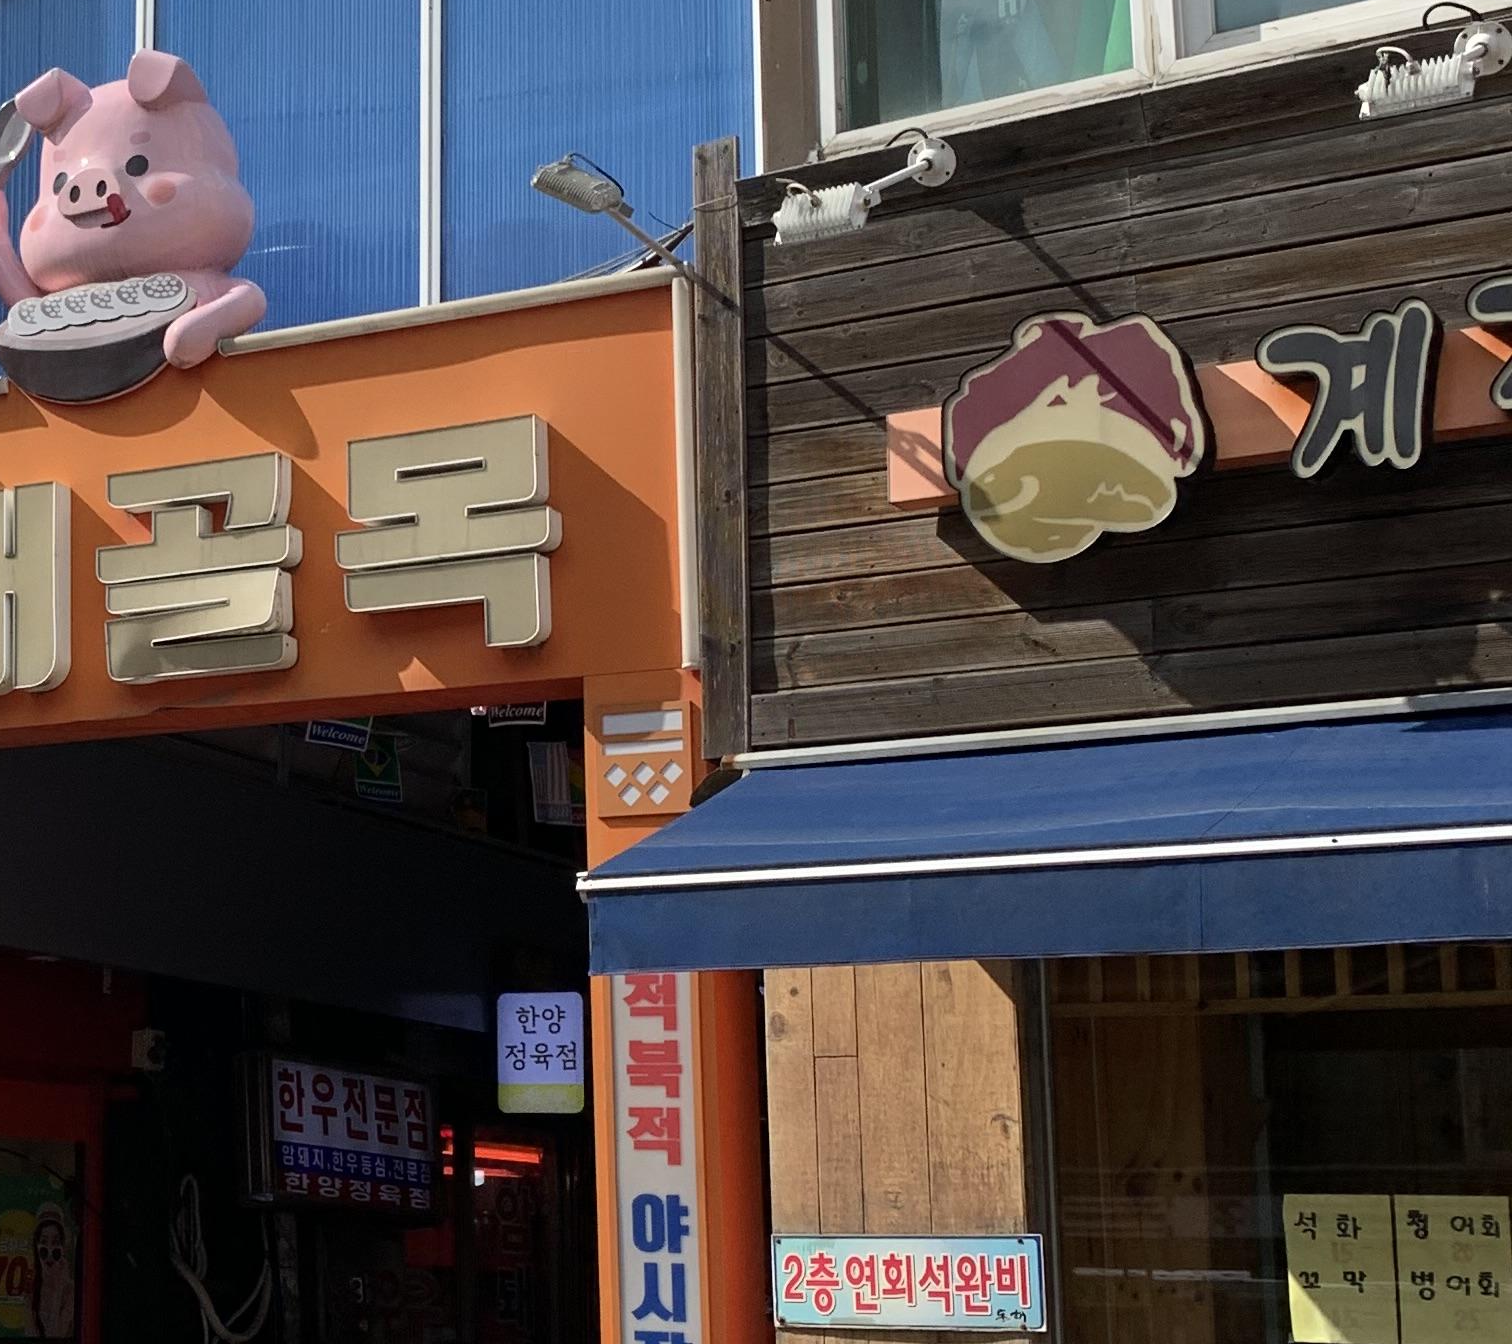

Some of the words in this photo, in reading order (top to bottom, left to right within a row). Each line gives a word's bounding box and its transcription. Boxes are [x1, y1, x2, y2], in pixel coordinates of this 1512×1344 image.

[490, 702, 545, 721] Welcome
[311, 723, 367, 745] Welcome
[516, 1004, 567, 1035] 한양
[505, 1041, 578, 1072] 정육점
[278, 1068, 428, 1151] 한우전문점
[284, 1171, 431, 1210] 한양정육점
